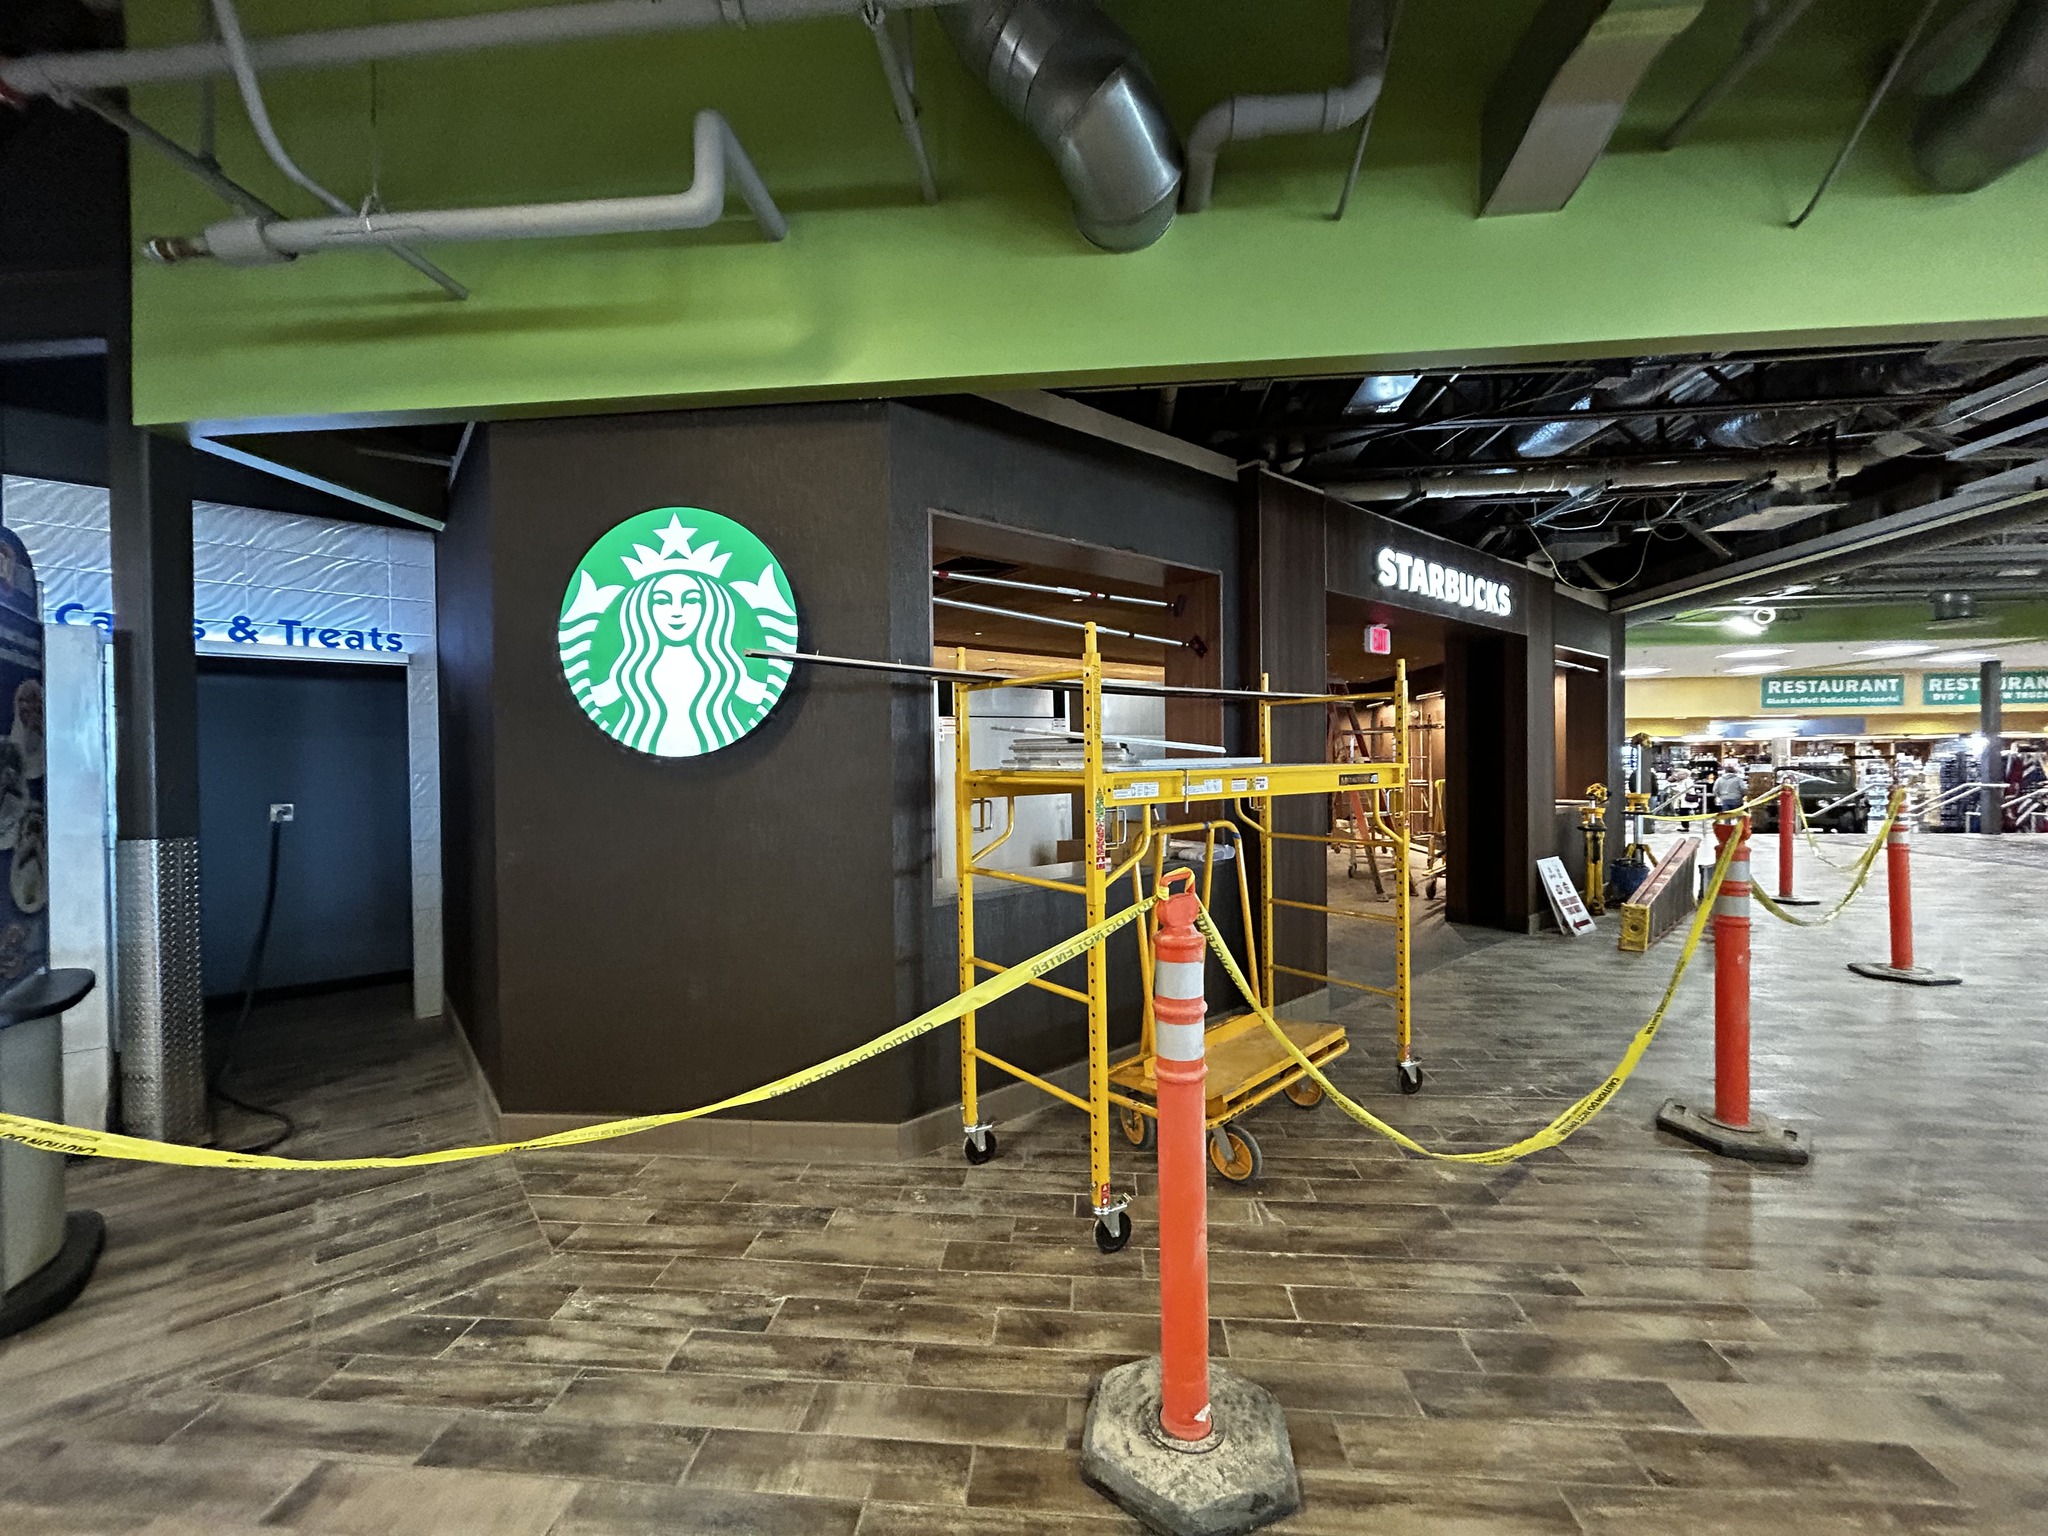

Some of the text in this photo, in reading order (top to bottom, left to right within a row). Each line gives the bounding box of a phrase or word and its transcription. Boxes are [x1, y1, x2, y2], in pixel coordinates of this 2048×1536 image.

[1377, 547, 1512, 616] STARBUCKS
[227, 615, 259, 643] &
[278, 619, 403, 652] Treats
[1767, 678, 1899, 694] RESTAURANT
[1594, 1077, 1621, 1103] CAUTION
[1586, 1101, 1600, 1111] DO
